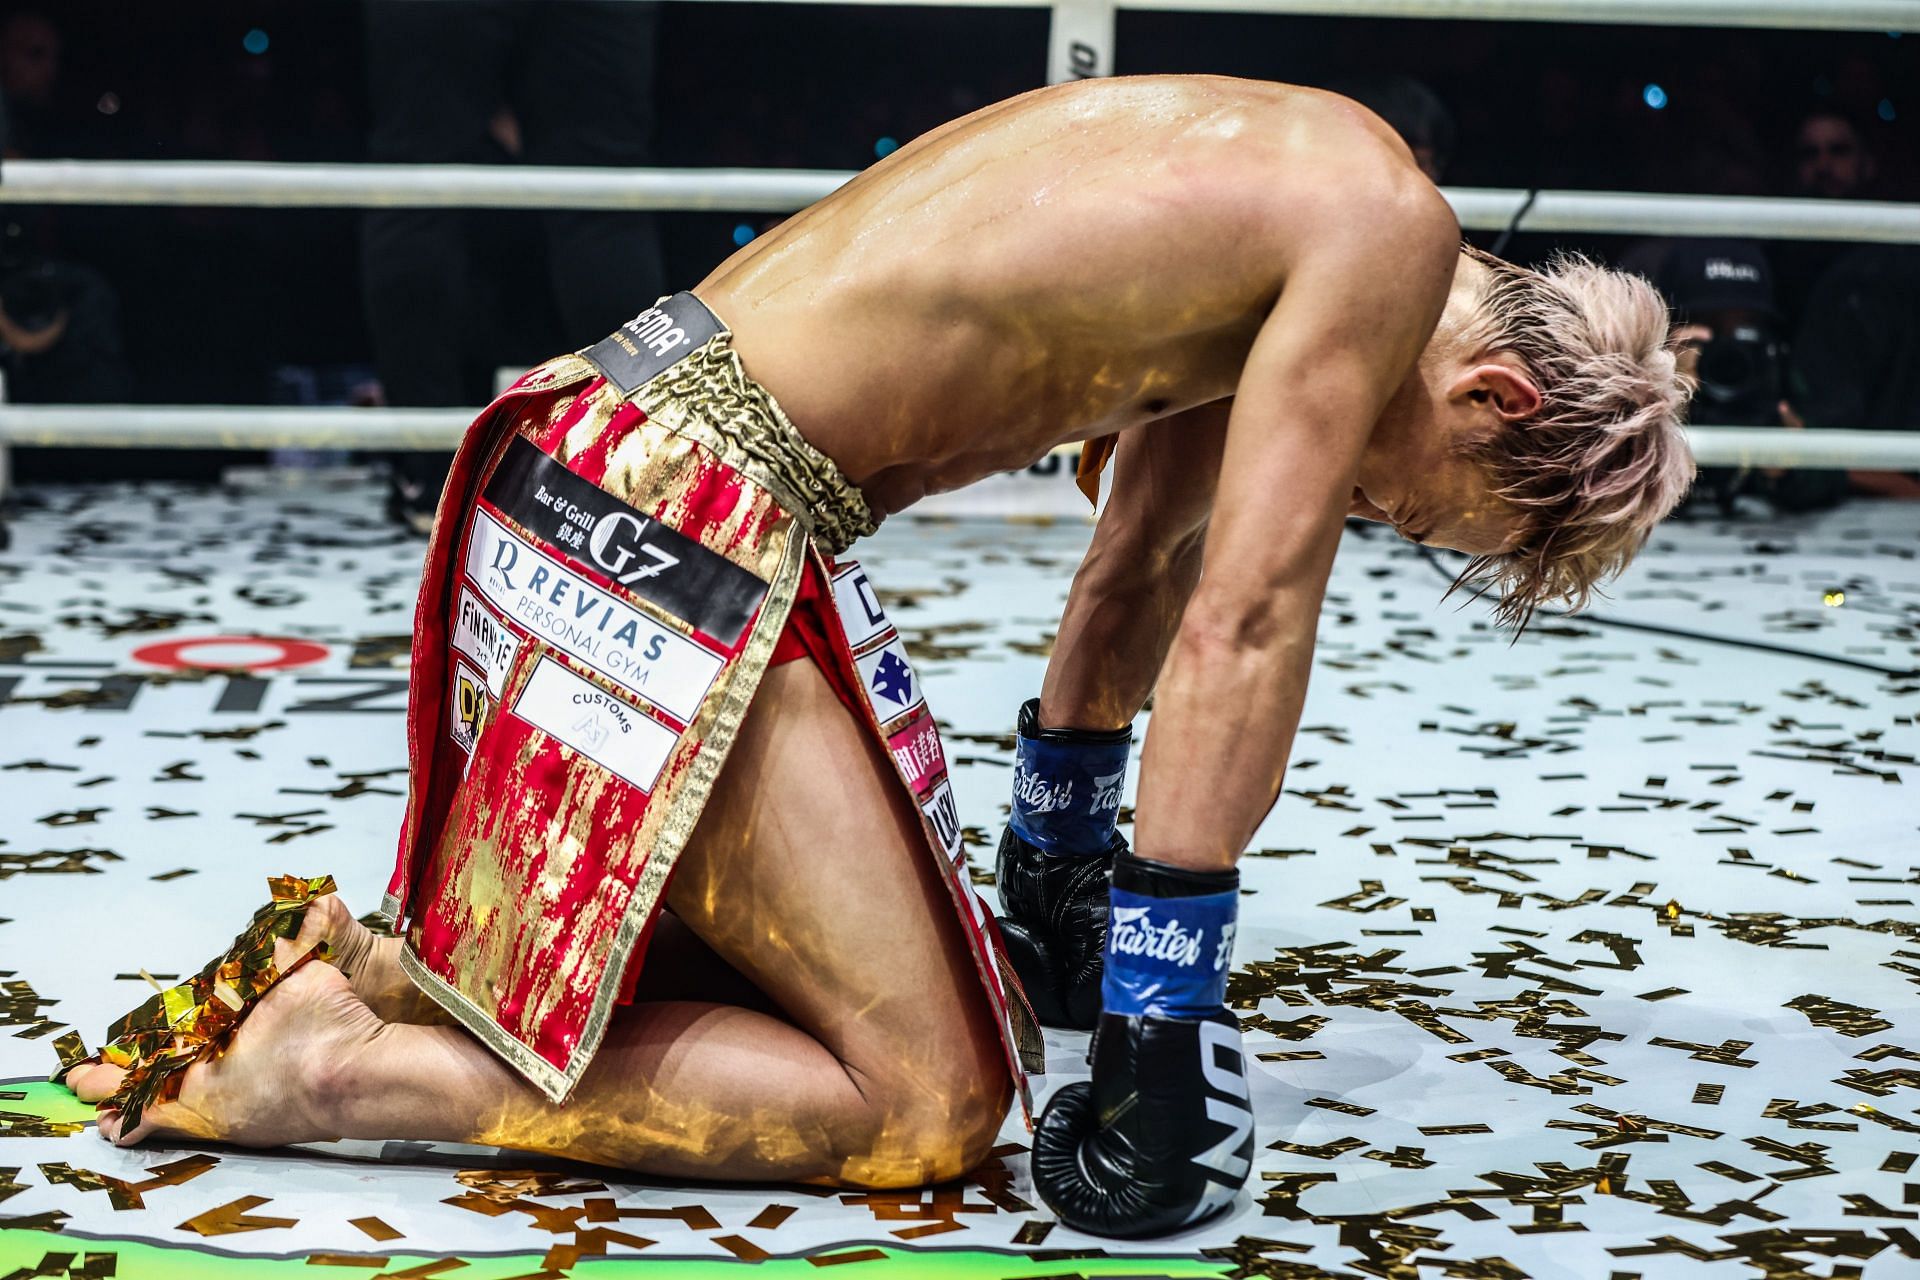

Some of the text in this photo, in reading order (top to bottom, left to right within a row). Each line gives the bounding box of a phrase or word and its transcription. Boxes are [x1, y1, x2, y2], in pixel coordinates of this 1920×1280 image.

[534, 485, 597, 532] Bar & Grill
[555, 521, 586, 551] 銀座
[589, 511, 681, 585] G7
[516, 595, 650, 686] PERSONAL GYM
[527, 565, 668, 661] REVIAS
[572, 693, 632, 734] CUSTOMS
[1110, 906, 1203, 968] Fairtex
